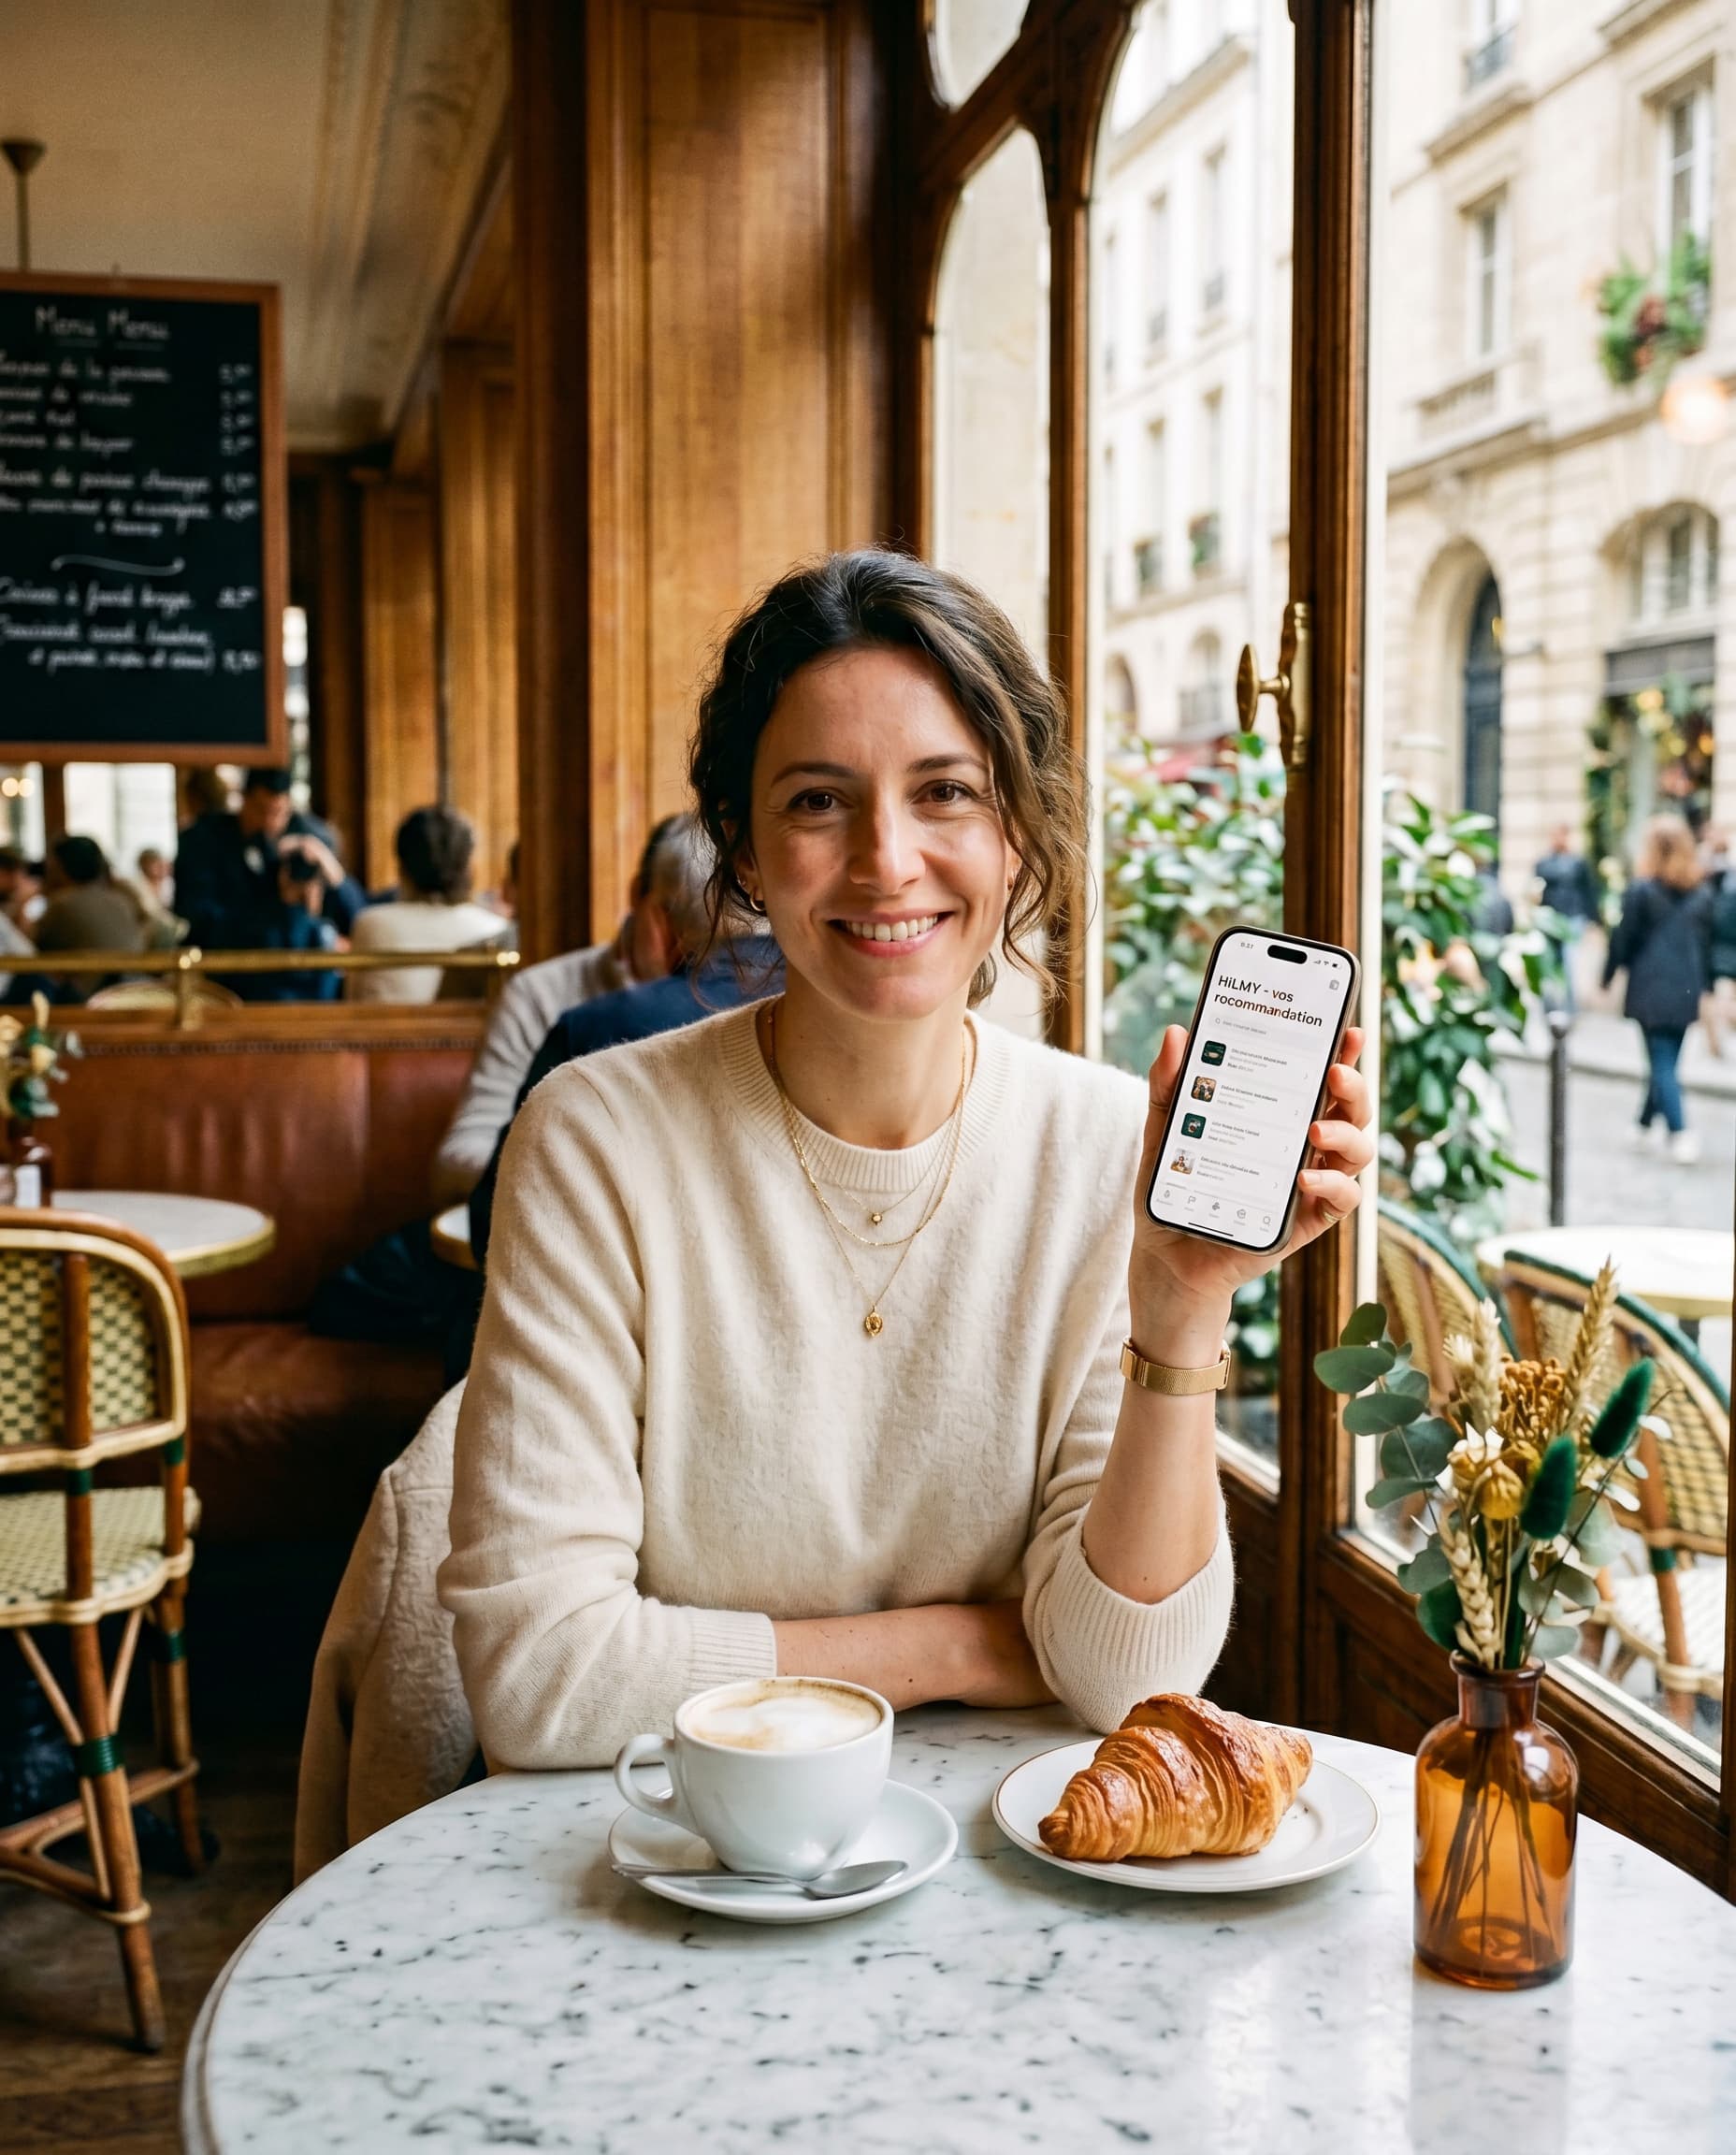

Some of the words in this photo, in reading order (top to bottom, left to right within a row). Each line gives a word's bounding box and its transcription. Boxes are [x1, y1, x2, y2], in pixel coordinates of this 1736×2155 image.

[1218, 975, 1261, 994] HiLMY
[1272, 990, 1294, 1003] vos
[1214, 993, 1324, 1027] rocommandation
